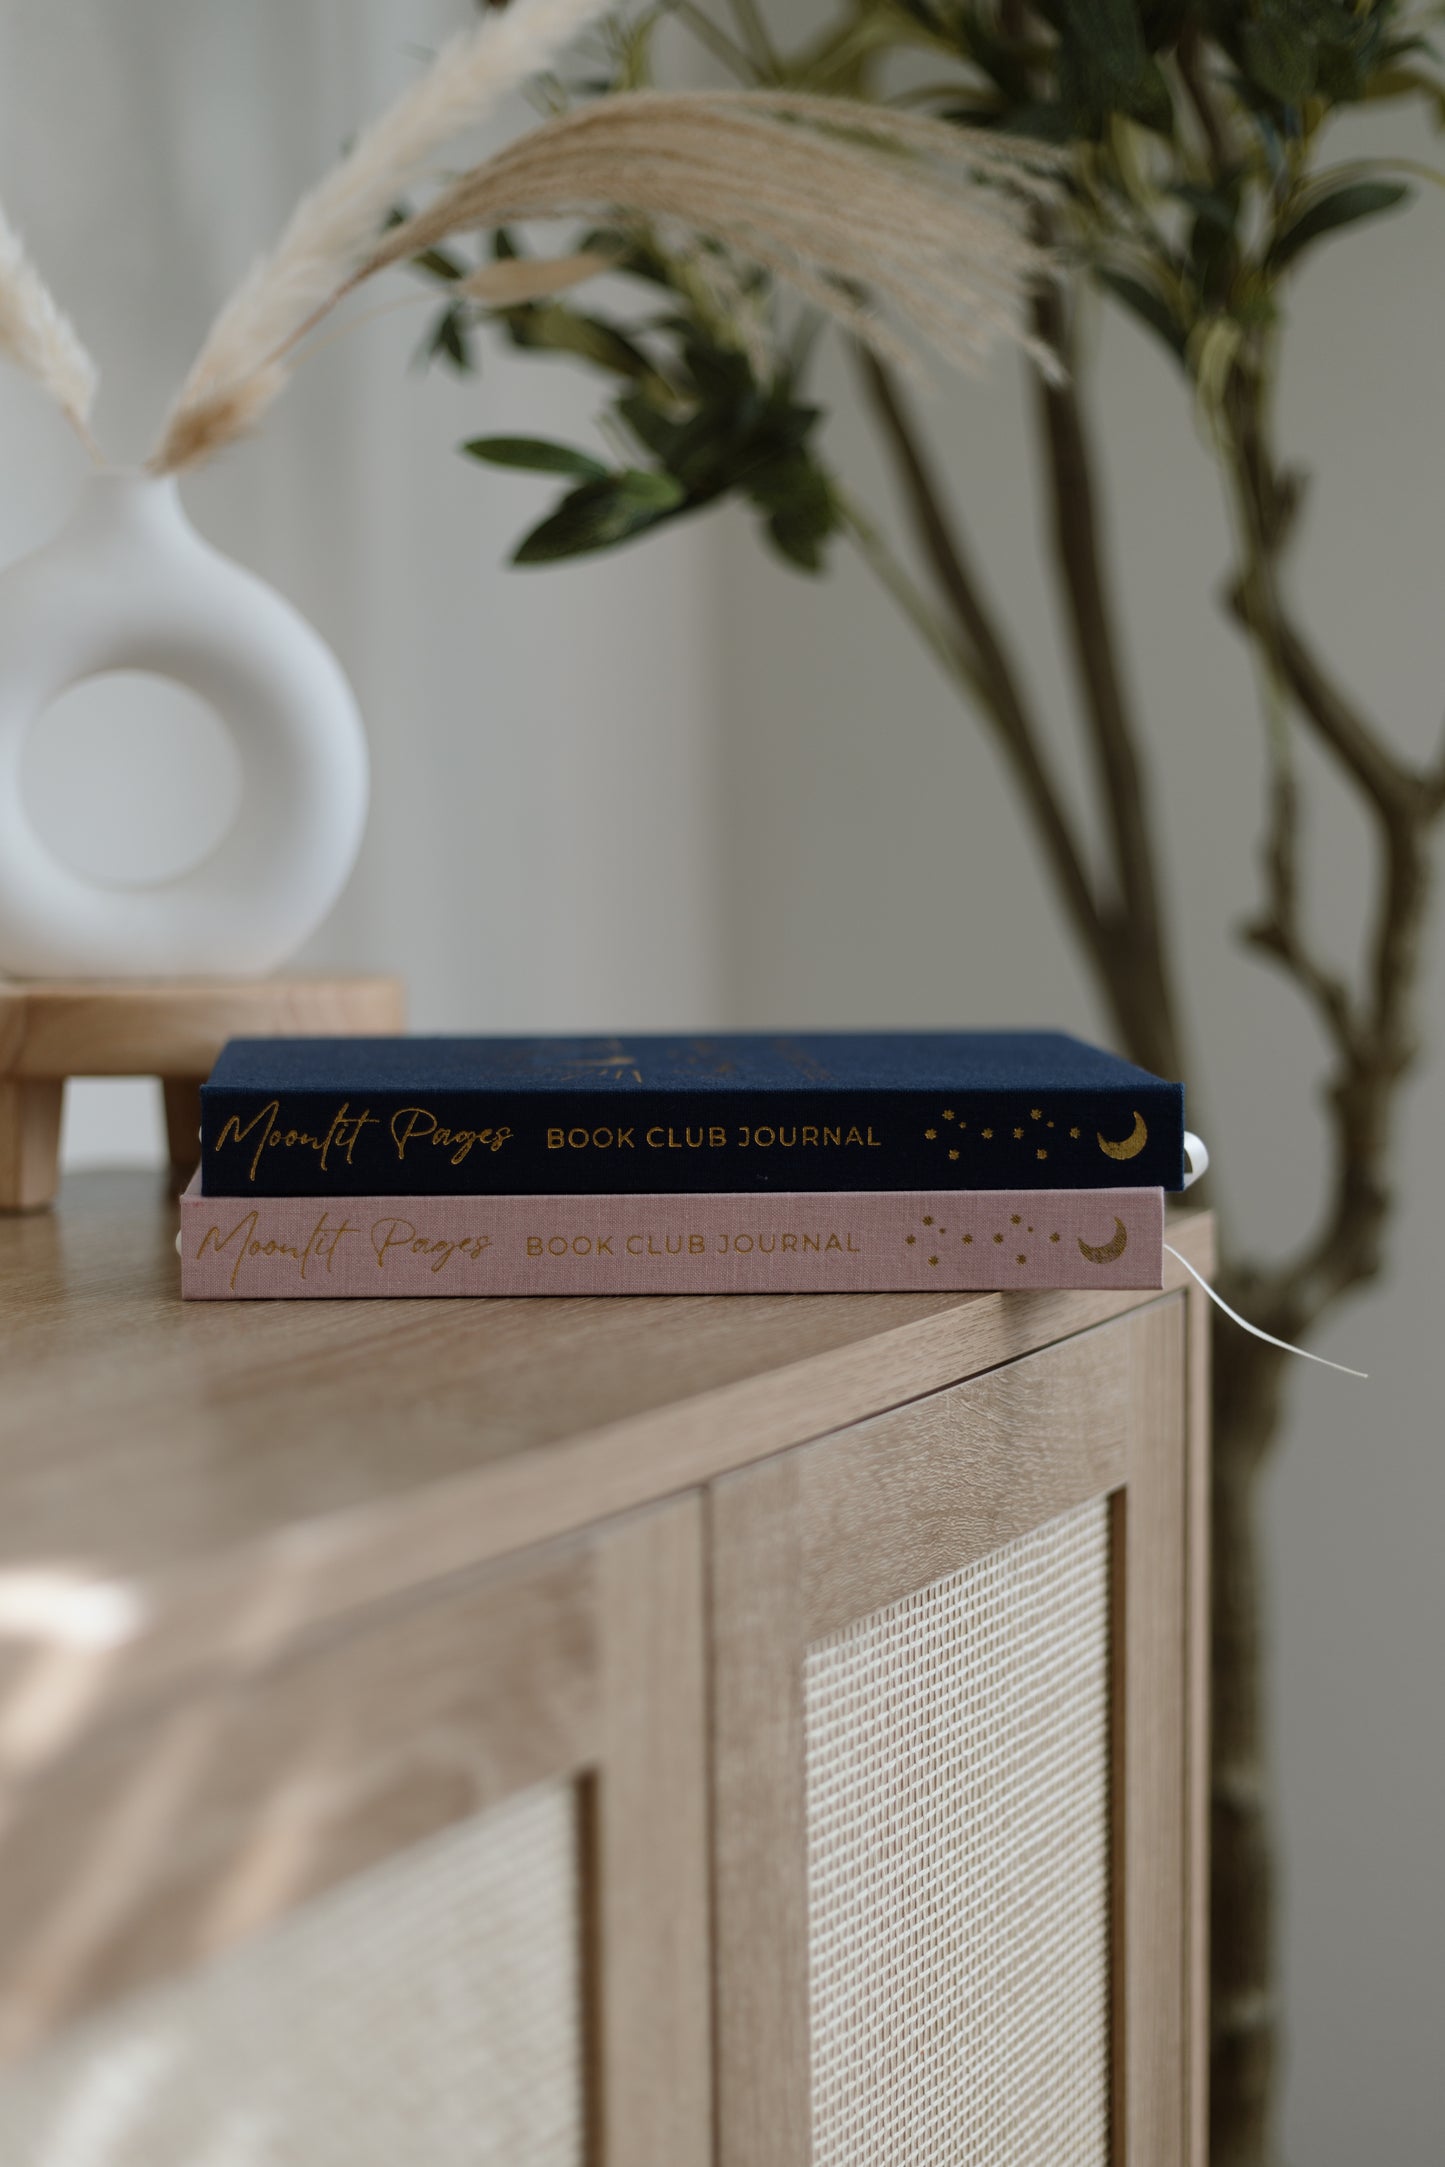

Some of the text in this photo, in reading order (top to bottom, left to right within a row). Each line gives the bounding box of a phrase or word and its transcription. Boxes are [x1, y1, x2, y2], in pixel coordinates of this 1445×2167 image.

[215, 1100, 881, 1181] Moonlit Pages BOOK CLUB JOURNAL
[196, 1211, 861, 1291] Moonlit Pages BOOK CLUB JOURNAL
